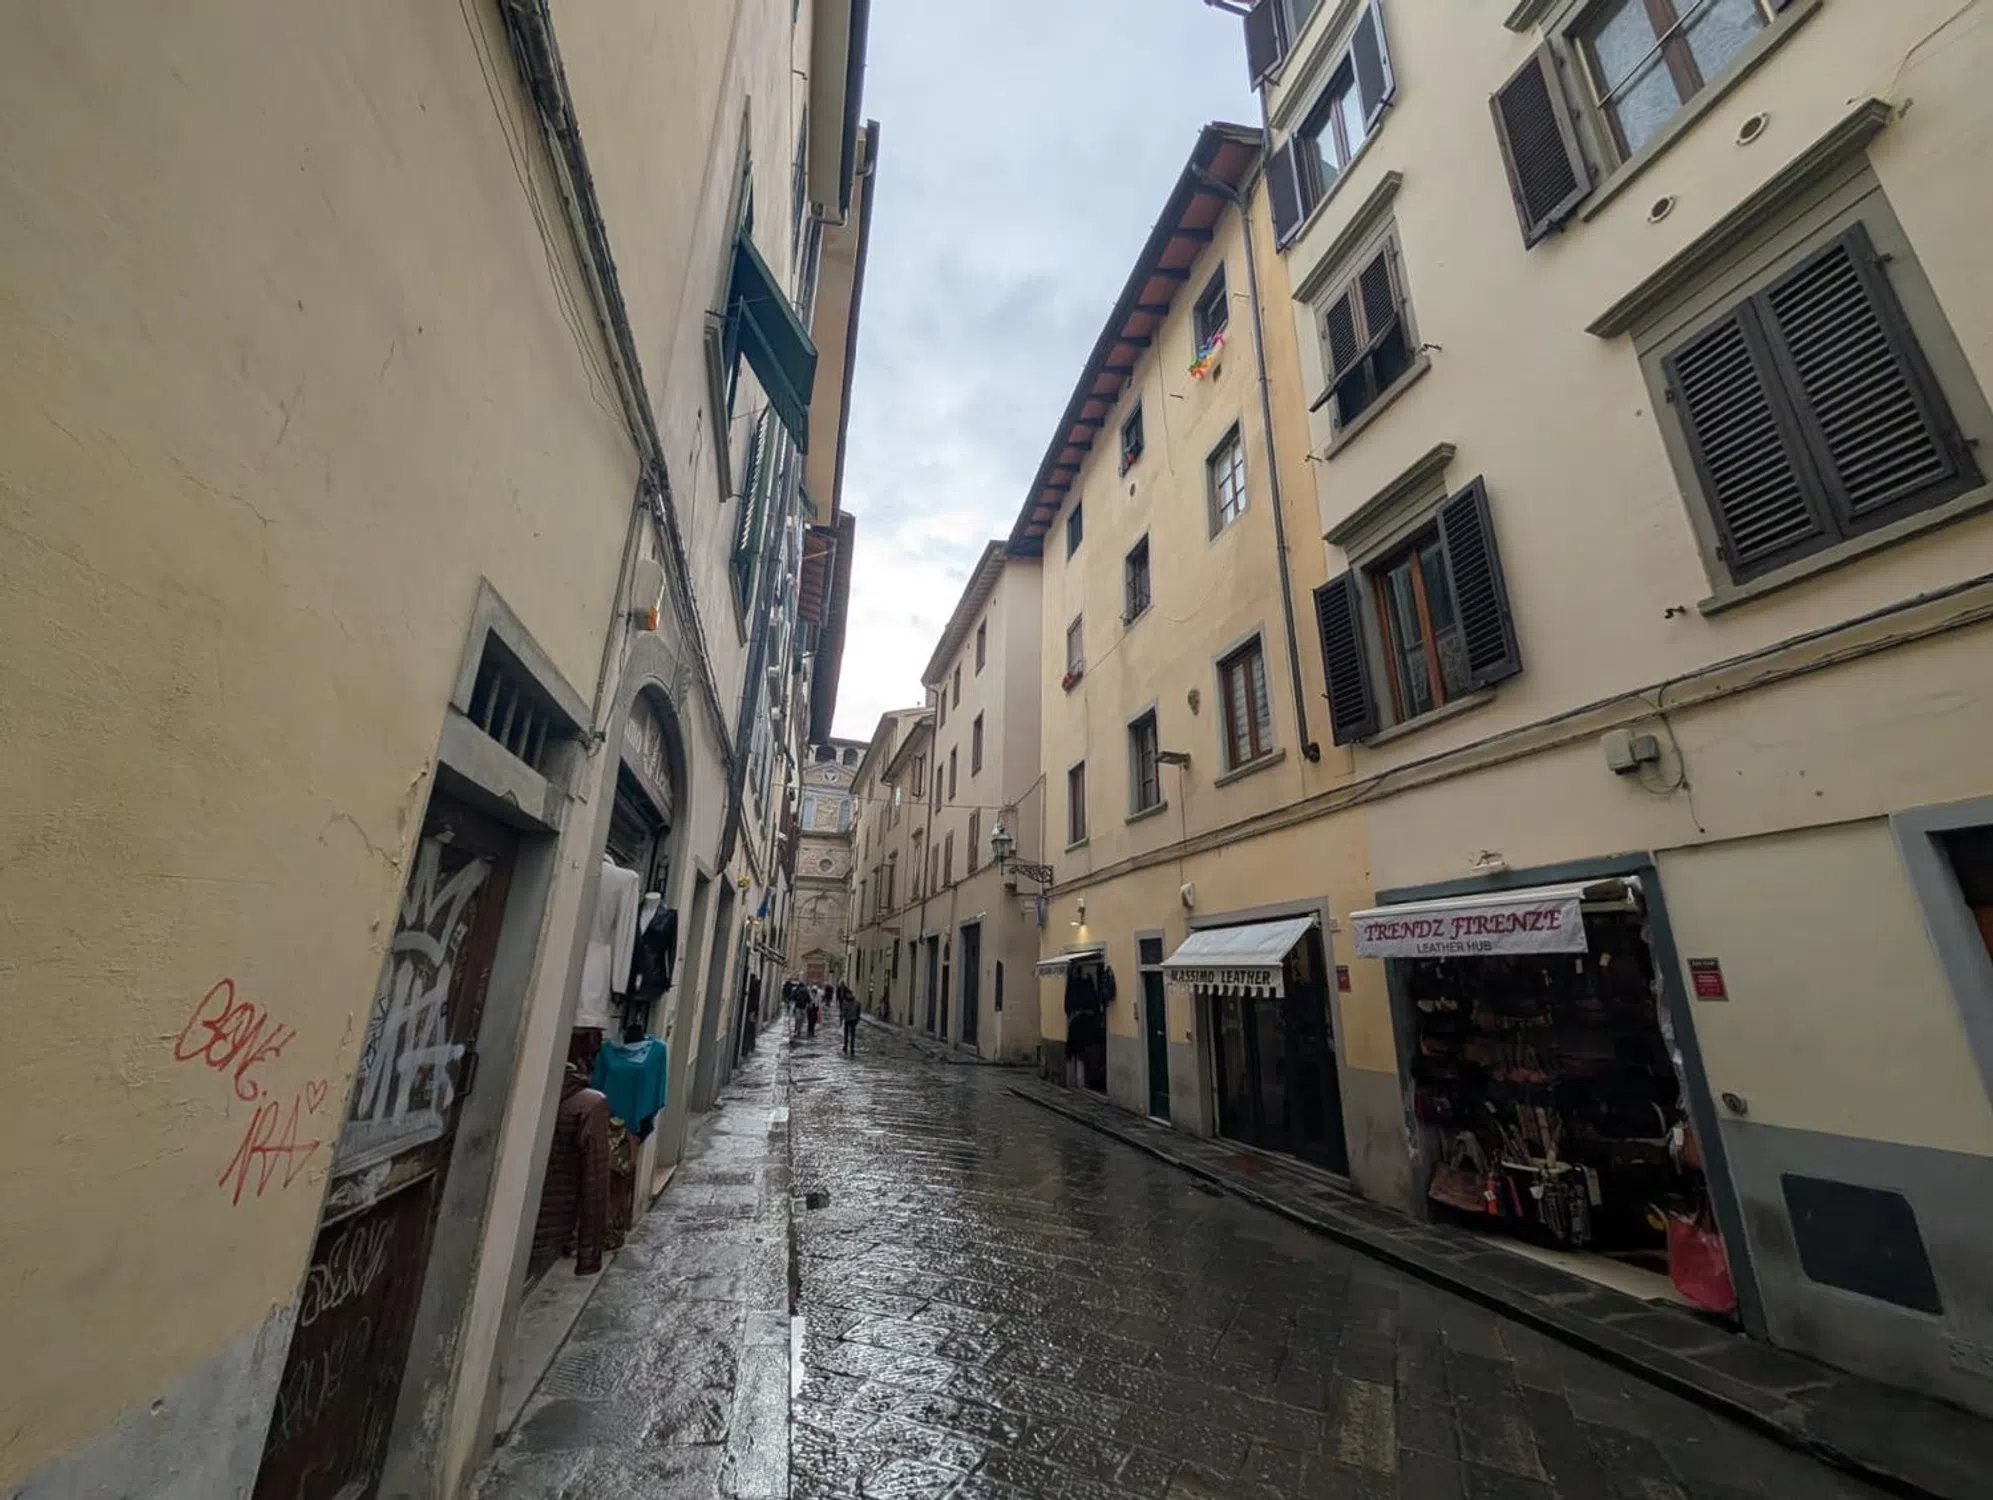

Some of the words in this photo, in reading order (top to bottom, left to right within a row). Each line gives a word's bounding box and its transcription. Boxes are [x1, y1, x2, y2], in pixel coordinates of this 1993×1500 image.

[1365, 918, 1446, 941] TRENDZ
[1451, 909, 1562, 940] FIRENZE
[1416, 940, 1464, 954] LEATHER
[1466, 939, 1493, 952] HUB
[1171, 969, 1214, 983] MASSIMO
[1221, 970, 1271, 986] LEATHER
